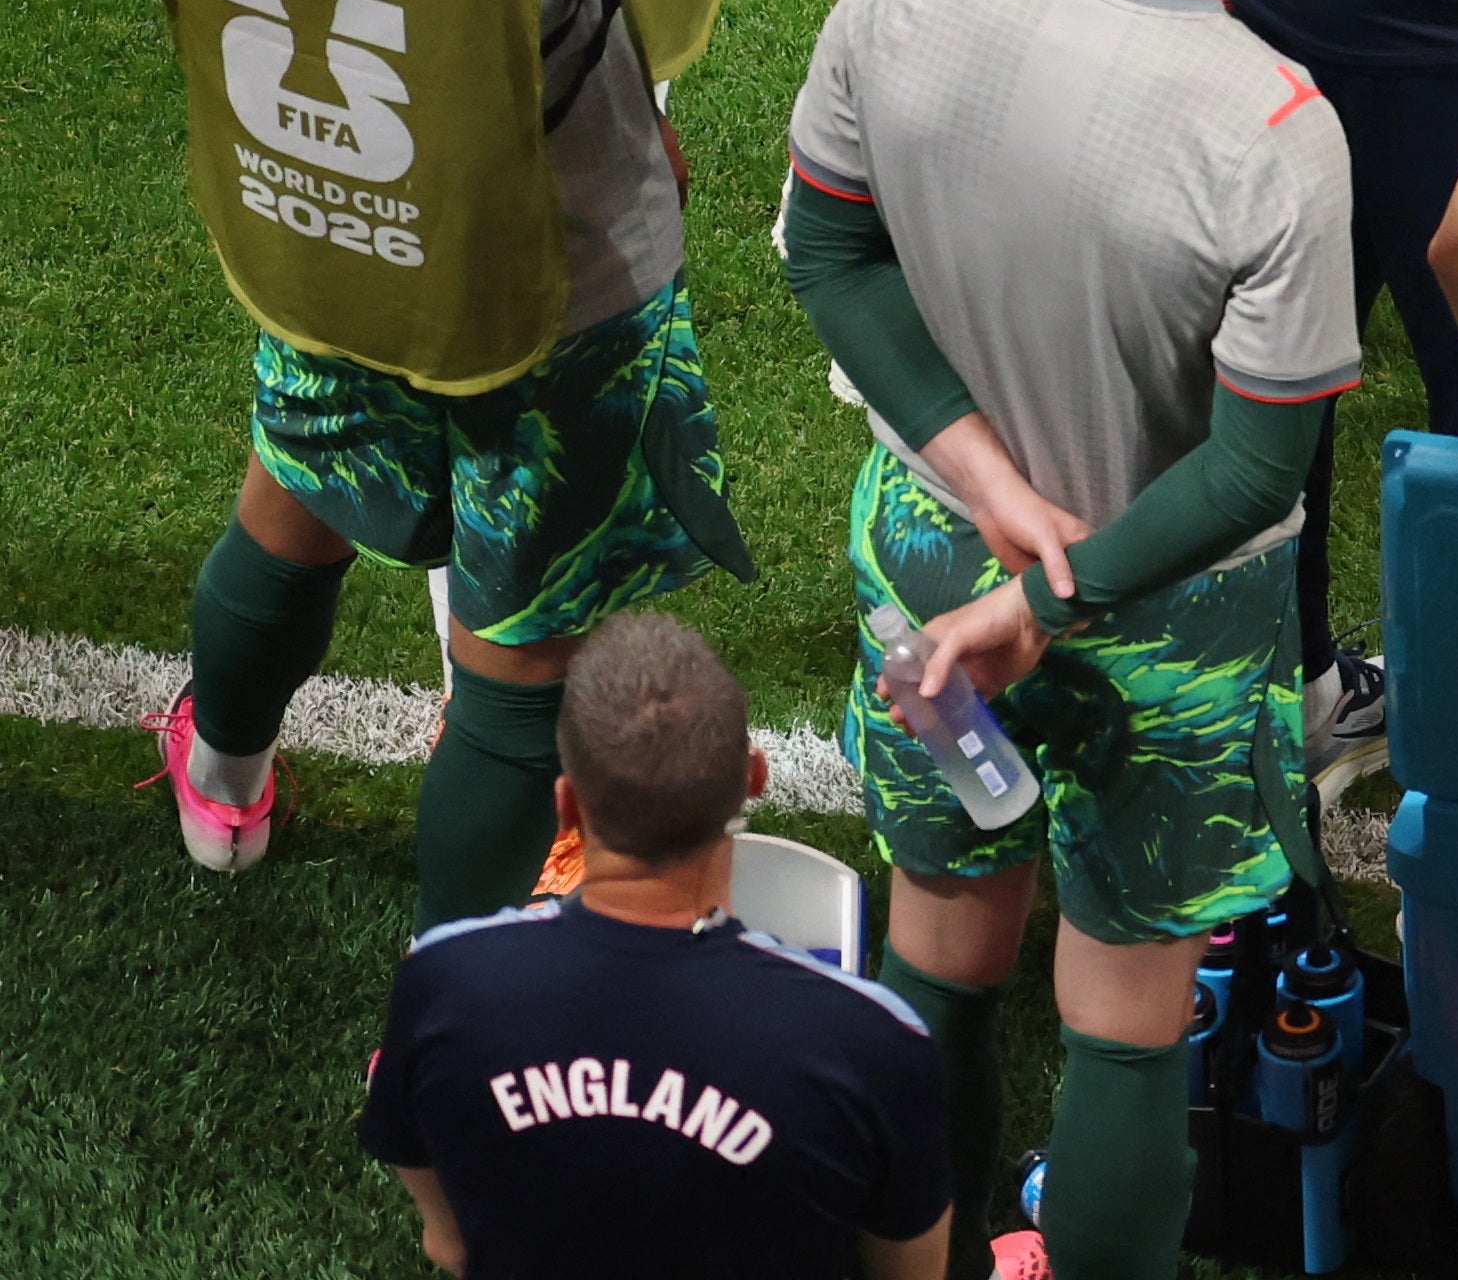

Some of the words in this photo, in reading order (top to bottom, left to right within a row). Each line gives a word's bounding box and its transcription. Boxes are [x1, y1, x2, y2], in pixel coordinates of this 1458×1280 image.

[277, 101, 362, 155] FIFA
[233, 142, 347, 206] WORLD
[352, 191, 421, 224] CUP
[239, 175, 425, 268] 2026
[490, 1055, 773, 1166] ENGLAND
